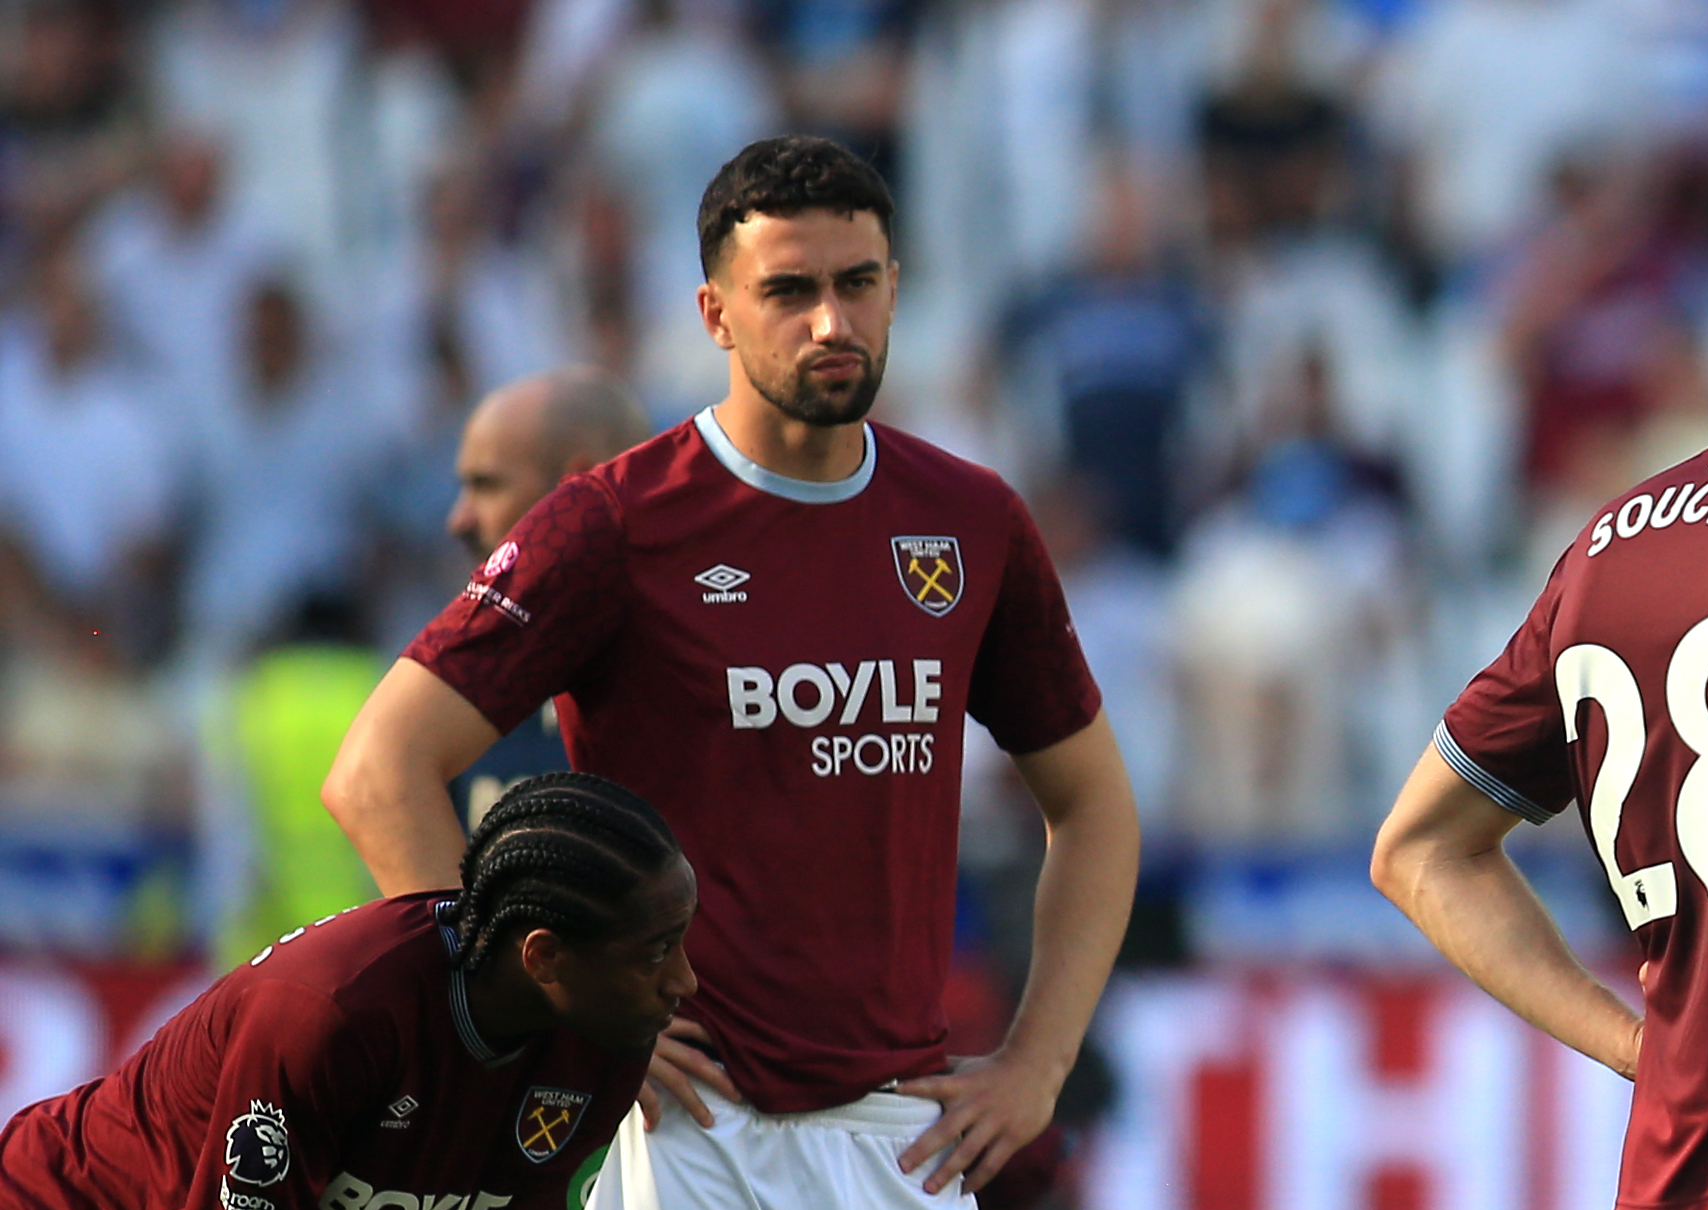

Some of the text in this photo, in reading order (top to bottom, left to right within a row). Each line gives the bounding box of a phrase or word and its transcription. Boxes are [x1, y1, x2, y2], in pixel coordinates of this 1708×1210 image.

[703, 591, 747, 603] umbro
[726, 658, 942, 729] BOYLE
[811, 734, 934, 777] SPORTS
